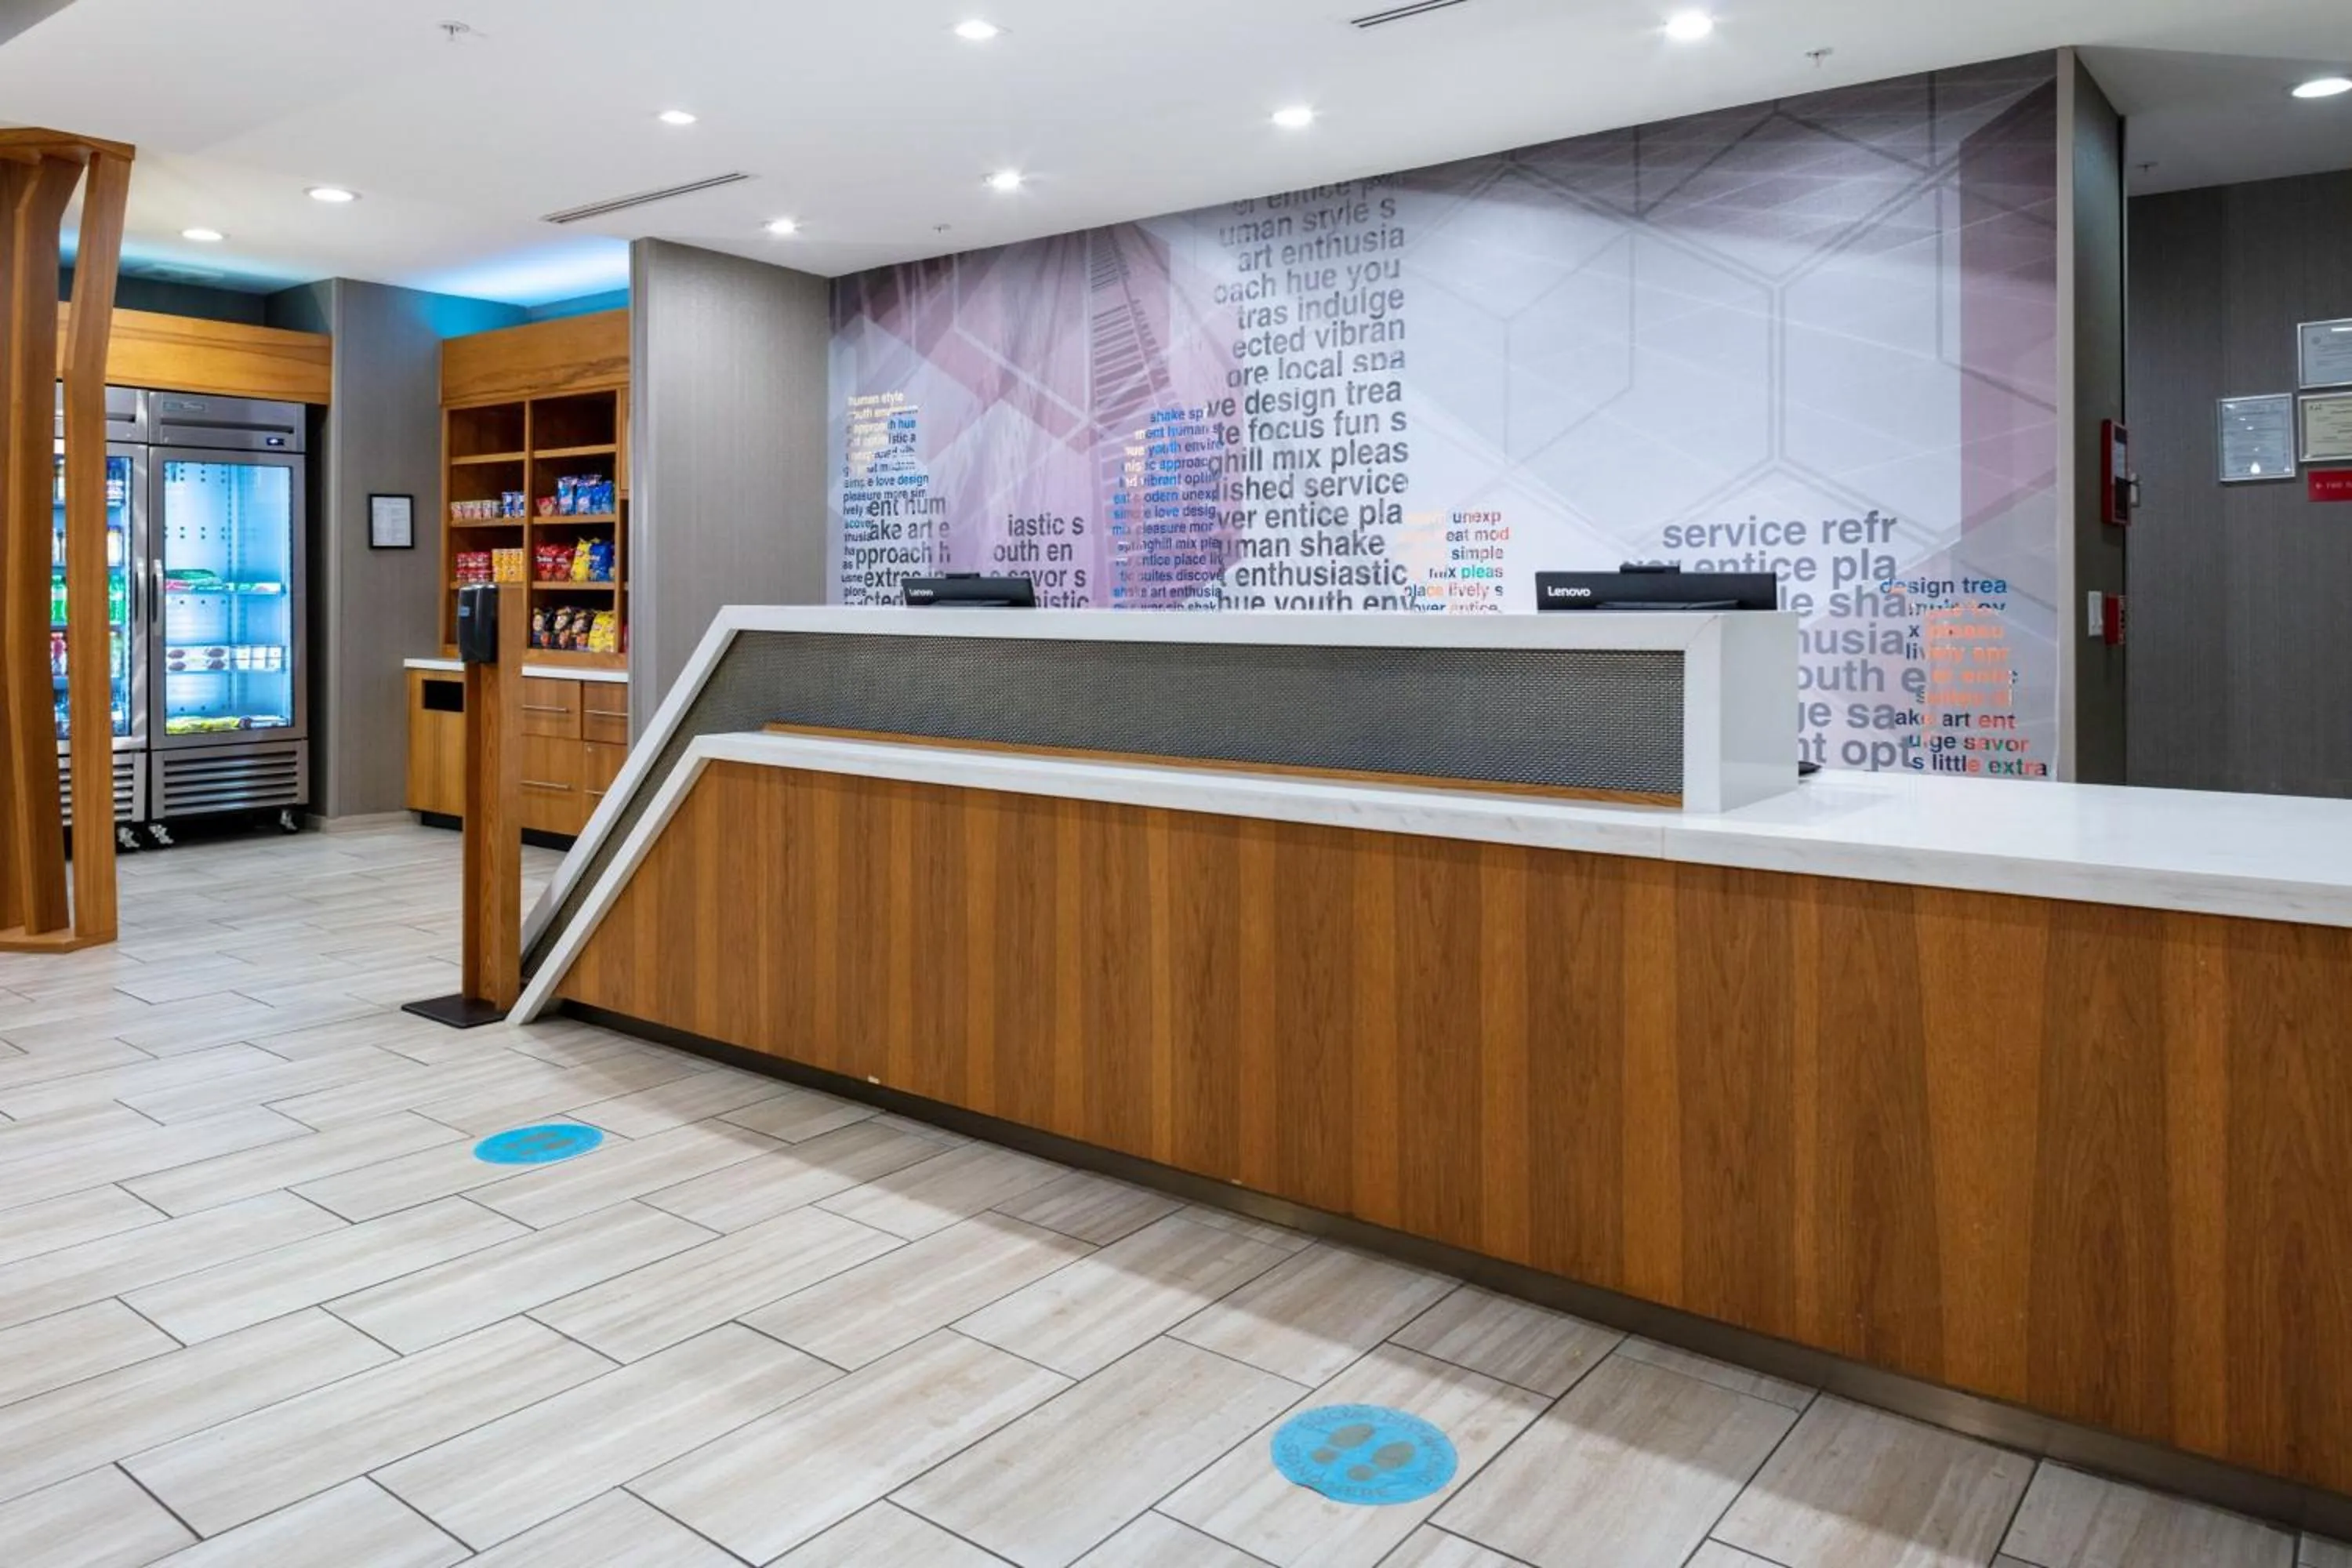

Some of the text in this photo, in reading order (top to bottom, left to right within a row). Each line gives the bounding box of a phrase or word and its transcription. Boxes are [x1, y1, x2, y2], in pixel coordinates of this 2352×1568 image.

[1301, 200, 1369, 234] style
[1379, 197, 1396, 220] s
[1237, 223, 1405, 273] art enthusia
[1214, 257, 1401, 304] oach hue you
[1237, 286, 1405, 330] tras indulge
[1232, 318, 1406, 359] ected vibran
[1226, 364, 1269, 388] ore
[1278, 350, 1343, 380] local
[1244, 385, 1336, 418] design
[1345, 379, 1403, 407] trea
[1247, 416, 1325, 443] focus
[1332, 409, 1380, 437] fun
[1389, 410, 1407, 432] s
[1208, 445, 1264, 478] ghill
[1330, 438, 1410, 474] pleas
[1304, 469, 1410, 498] service
[869, 499, 899, 517] ent
[1215, 497, 1403, 535] ver entice pla
[1452, 510, 1502, 526] unexp
[869, 512, 1084, 540] ake art e iastic s
[1446, 526, 1510, 543] eat mod
[1662, 510, 1898, 550] service refr
[855, 542, 932, 570] pproach
[993, 539, 1040, 562] outh
[1047, 543, 1073, 561] en
[1300, 528, 1385, 557] shake
[1451, 545, 1504, 564] simple
[1074, 569, 1086, 588] s
[1235, 557, 1408, 587] enthusiastic
[1461, 563, 1504, 580] pleas
[1831, 548, 1896, 590] pla
[1548, 586, 1592, 598] Lenovo
[1962, 577, 2007, 594] trea
[1828, 584, 1907, 619] sha
[1846, 702, 1896, 730] sa
[1942, 711, 1970, 728] art
[1978, 714, 2016, 730] ent
[1962, 735, 2029, 753] savor
[1932, 753, 1981, 774] little
[1987, 759, 2048, 778] extra
